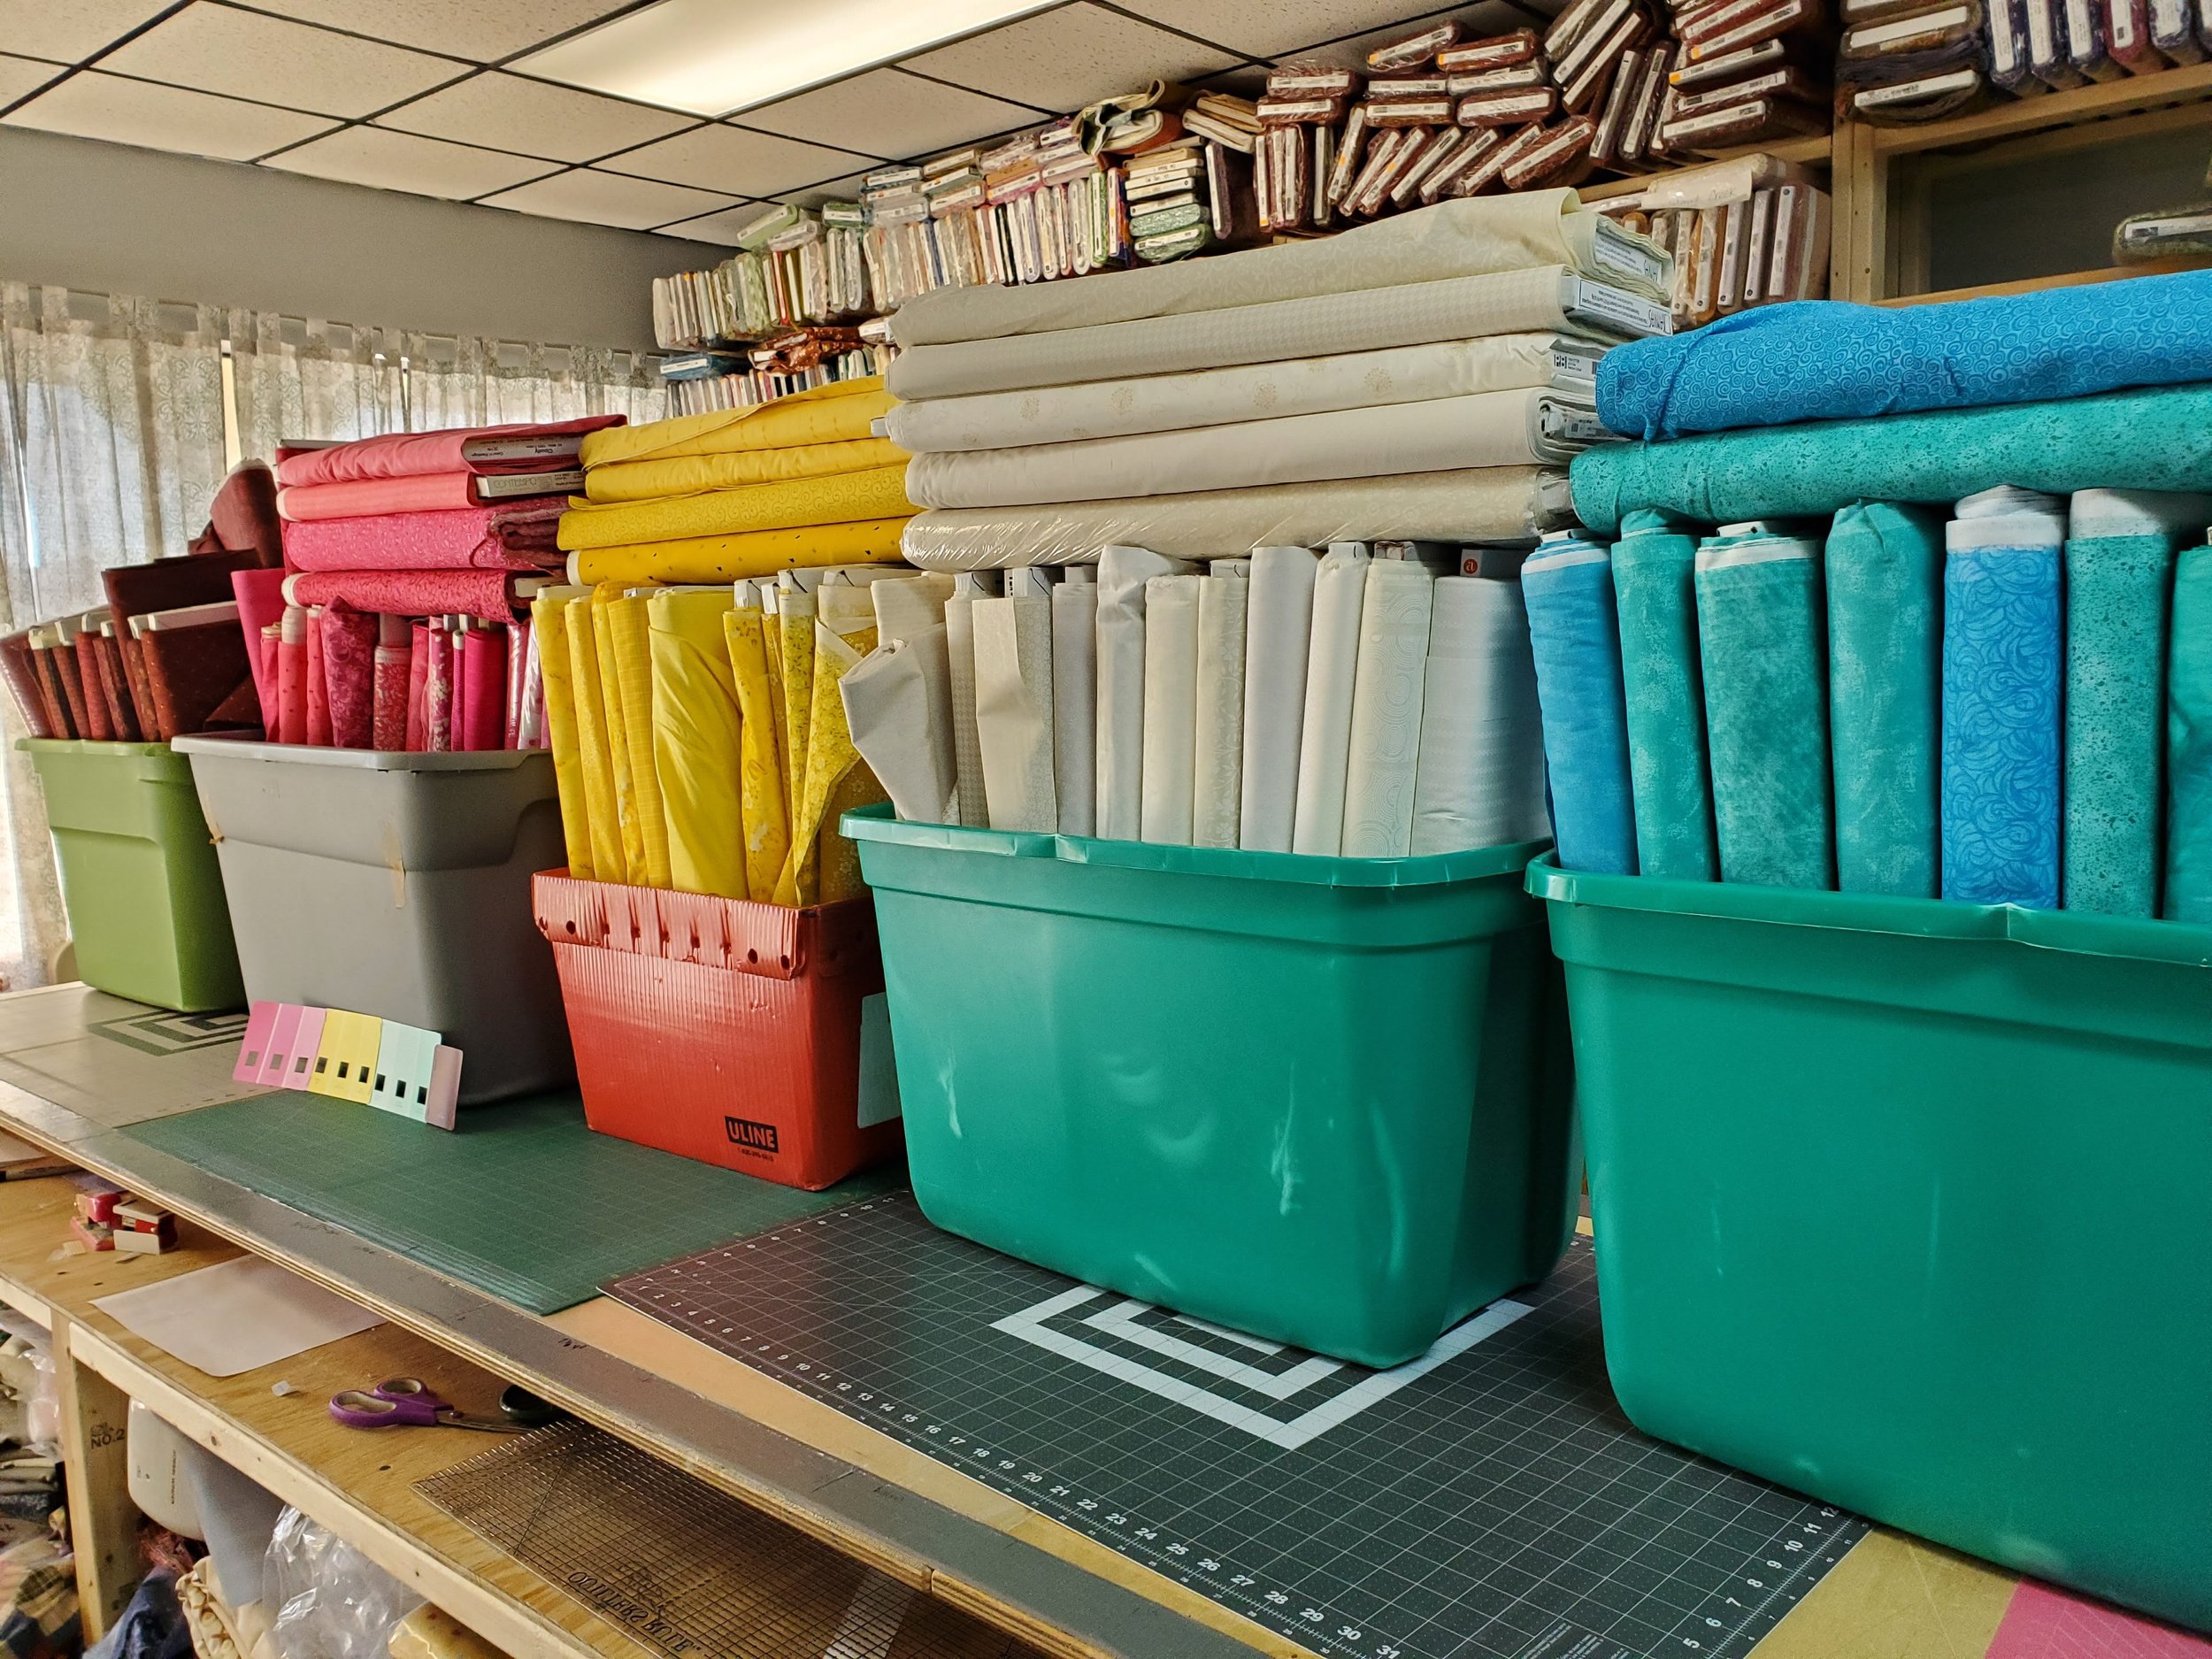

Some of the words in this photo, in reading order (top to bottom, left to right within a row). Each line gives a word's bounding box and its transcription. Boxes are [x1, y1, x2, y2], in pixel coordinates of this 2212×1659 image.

[728, 1121, 775, 1148] ULINE
[91, 1429, 126, 1449] NO.2
[835, 1382, 853, 1391] 12
[857, 1393, 874, 1402] 13
[879, 1402, 896, 1412] 14
[901, 1413, 919, 1423] 15
[924, 1425, 942, 1434] 16
[948, 1436, 967, 1445] 17
[972, 1448, 990, 1458] 18
[997, 1460, 1016, 1470] 19
[1021, 1471, 1043, 1483] 20
[1049, 1486, 1071, 1496] 21
[1076, 1498, 1099, 1511] 22
[1104, 1512, 1128, 1525] 23
[1133, 1527, 1158, 1540] 24
[1165, 1542, 1190, 1555] 25
[1196, 1558, 1221, 1571] 26
[1230, 1574, 1256, 1586] 27
[1263, 1590, 1289, 1605] 28
[1299, 1608, 1325, 1622] 29
[1337, 1625, 1362, 1640] 30
[1376, 1644, 1402, 1659] 31
[1682, 1637, 1701, 1649] 5
[1705, 1617, 1722, 1627] 6
[1724, 1596, 1742, 1608] 7
[1747, 1578, 1763, 1588] 8
[1766, 1560, 1783, 1570] 9
[1784, 1540, 1804, 1552] 10
[1802, 1522, 1822, 1534] 11
[1820, 1506, 1839, 1518] 12
